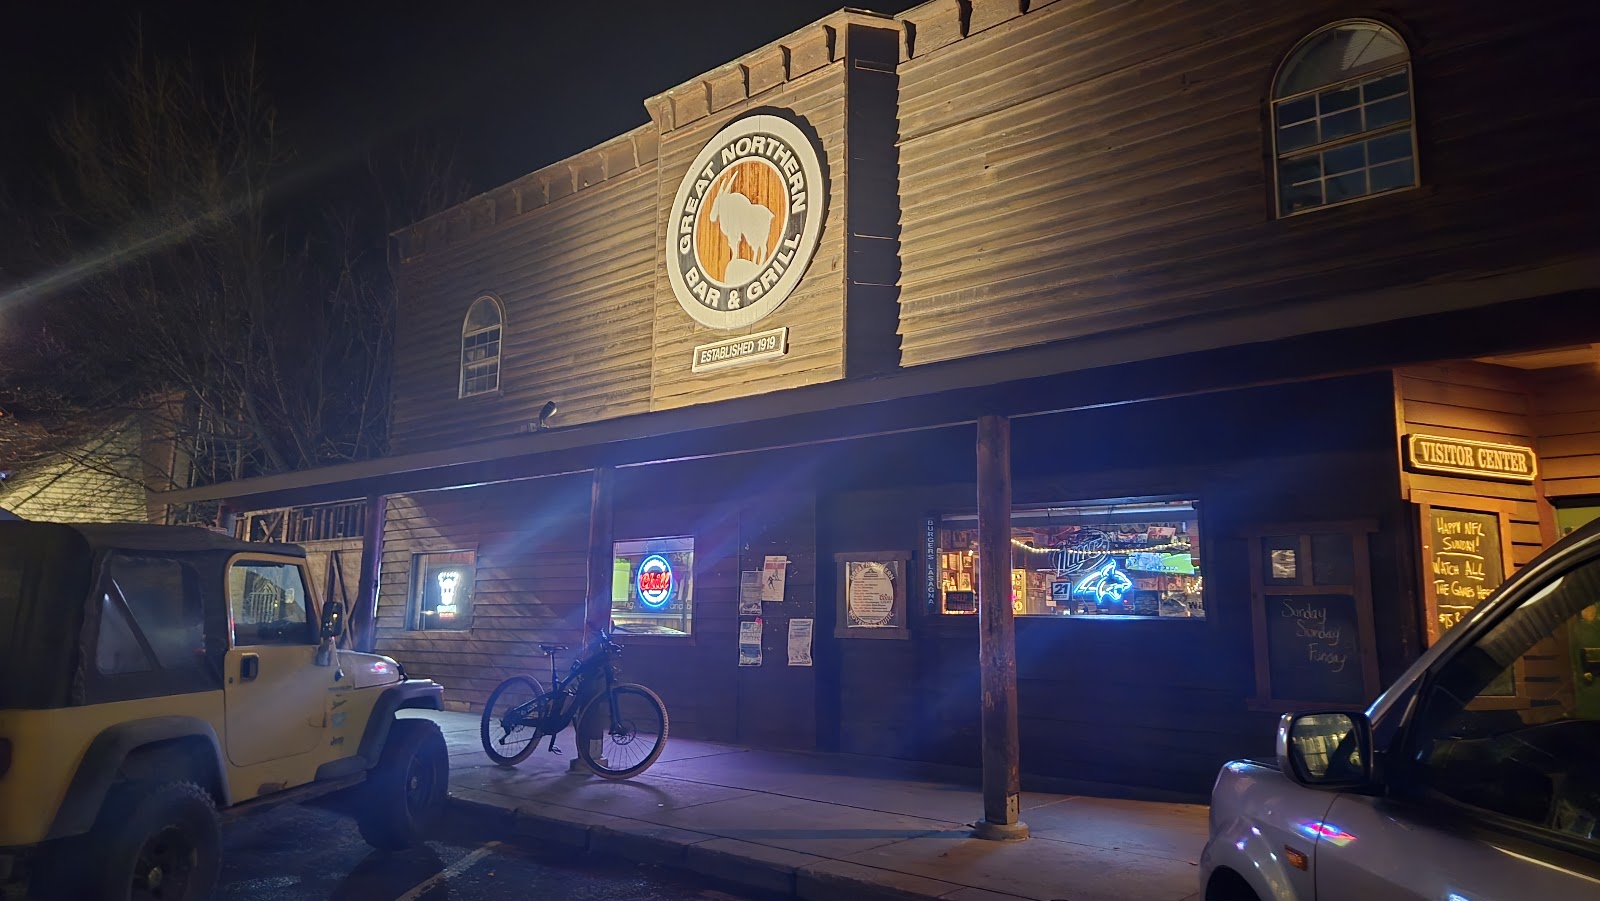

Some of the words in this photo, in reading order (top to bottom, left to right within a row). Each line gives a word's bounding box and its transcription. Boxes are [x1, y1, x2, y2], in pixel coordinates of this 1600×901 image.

[680, 161, 715, 255] GREAT
[721, 135, 806, 214] NORTHERN
[685, 266, 721, 309] BAR
[727, 289, 741, 309] &
[746, 233, 801, 300] GRILL
[700, 341, 755, 364] ESTABLISHED
[757, 336, 776, 352] 1919
[1420, 441, 1475, 467] VISITOR
[1478, 448, 1528, 473] CENTER
[1464, 522, 1486, 536] NFL
[1432, 557, 1460, 576] WATCH
[1465, 560, 1486, 576] ALL
[927, 563, 935, 605] LASAGNA
[1053, 584, 1069, 594] 21
[1433, 579, 1450, 596] THE
[1281, 599, 1327, 624] Sunday
